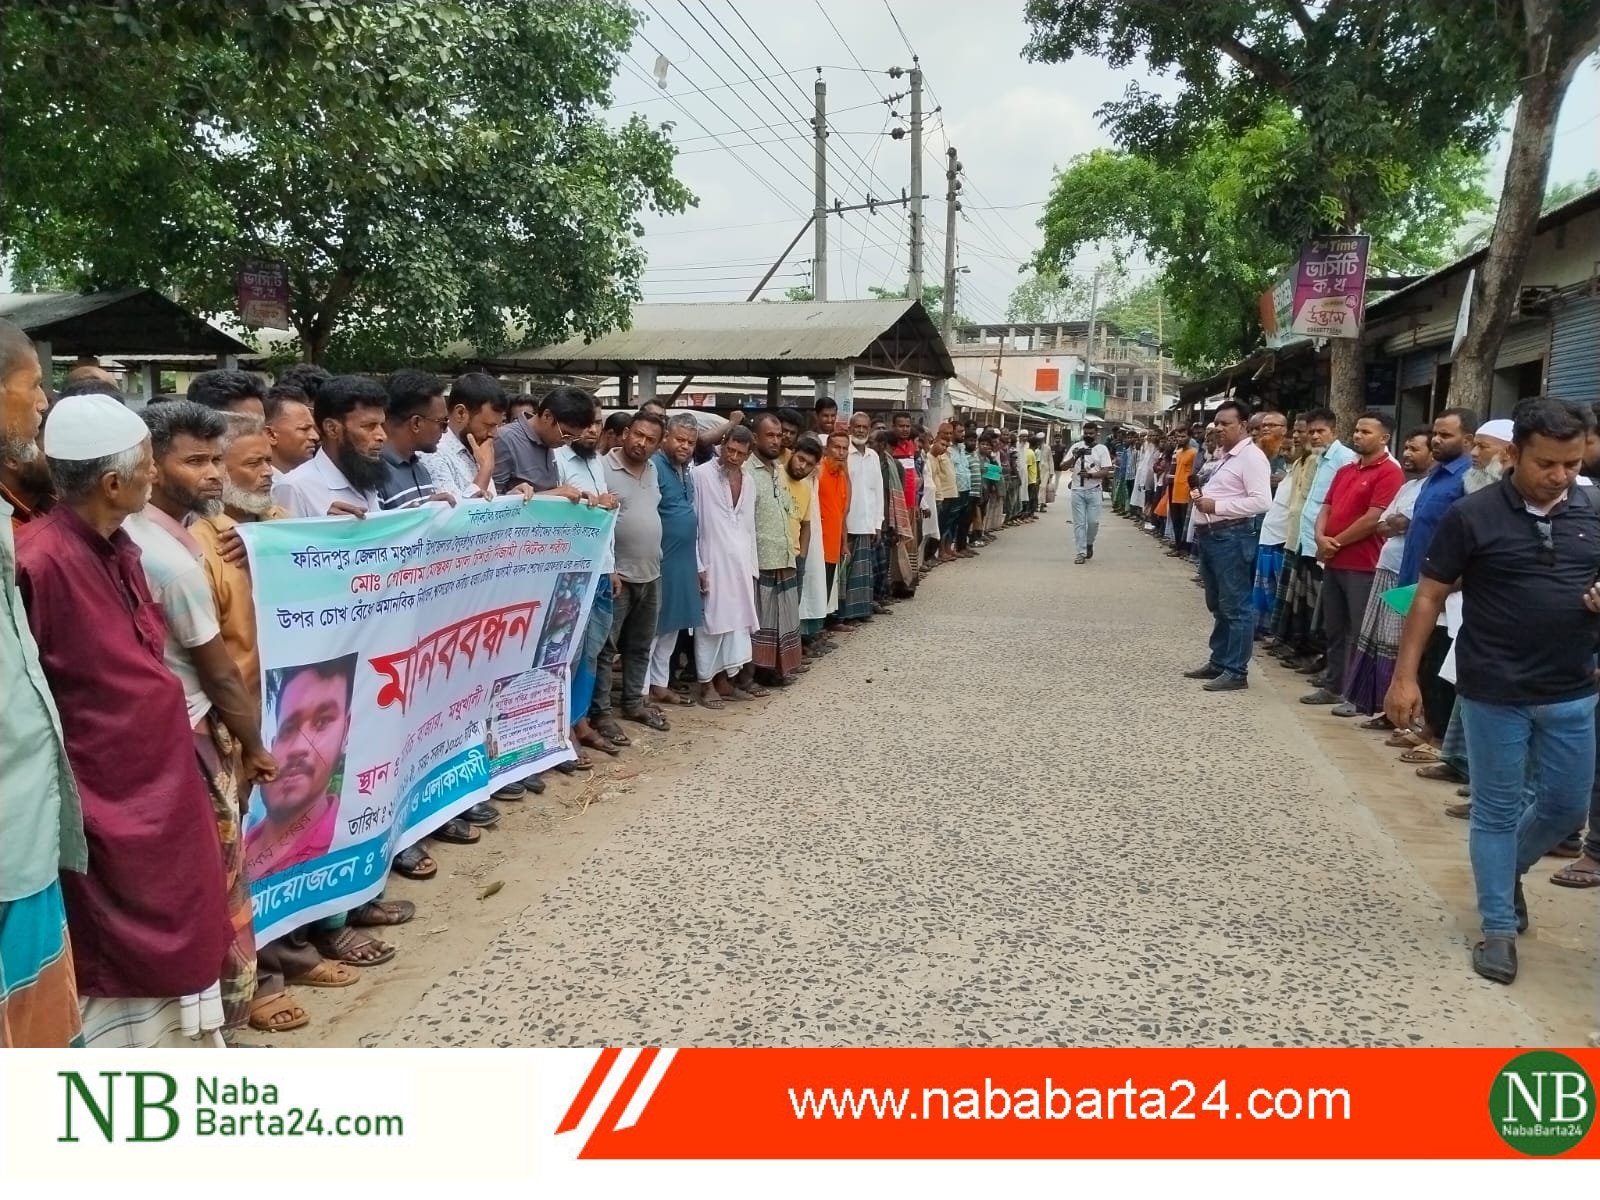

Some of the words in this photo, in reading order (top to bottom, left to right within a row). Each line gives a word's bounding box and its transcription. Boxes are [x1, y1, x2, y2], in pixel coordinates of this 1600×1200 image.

[1330, 240, 1358, 252] Time
[1305, 252, 1359, 277] ভার্সিটি
[291, 545, 350, 571] ফরিদপুর
[355, 547, 388, 566] জেলার
[351, 573, 381, 594] মোঃ
[387, 566, 426, 588] গোলাম
[277, 607, 314, 629] উপর
[320, 605, 348, 626] চোখ
[375, 591, 416, 616] অমানবিক
[368, 600, 541, 717] মানববন্ধন
[356, 762, 391, 795] স্থান
[448, 685, 483, 720] মধুখালী
[252, 856, 360, 918] আয়োজনে
[422, 750, 487, 804] এলাকাবাসী
[348, 807, 381, 836] তারিখ
